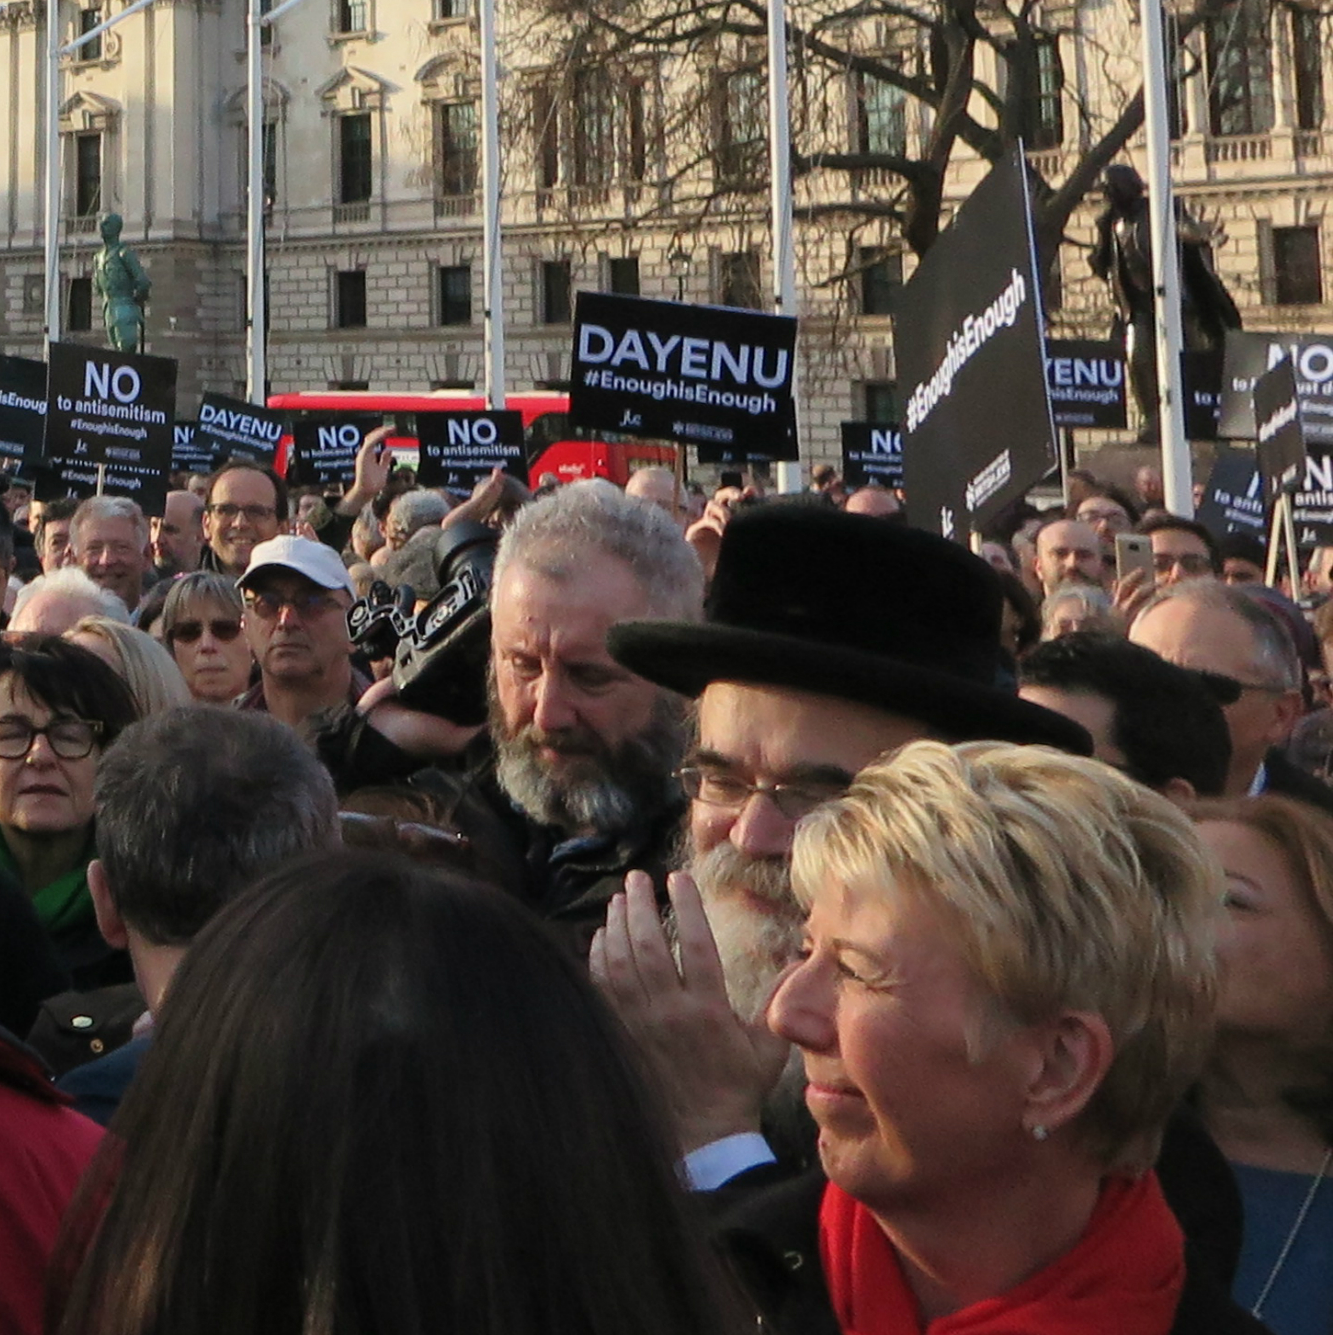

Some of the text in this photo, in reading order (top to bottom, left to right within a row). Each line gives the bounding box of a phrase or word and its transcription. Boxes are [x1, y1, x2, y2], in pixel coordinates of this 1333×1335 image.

[578, 323, 788, 389] DAYENU
[906, 267, 1026, 434] #EnoughisEnough
[84, 360, 141, 404] NO
[584, 369, 777, 415] #EnoughisEnough
[1232, 377, 1246, 391] to
[57, 395, 166, 425] to antisemitism
[1194, 391, 1211, 405] to
[70, 419, 148, 440] #EnoughisEnough
[174, 425, 194, 443] N
[200, 405, 282, 441] DAYENU
[448, 418, 498, 445] NO
[318, 424, 360, 450] NO
[427, 443, 521, 457] to antisemitism
[1303, 455, 1333, 492] N
[1214, 489, 1230, 504] to
